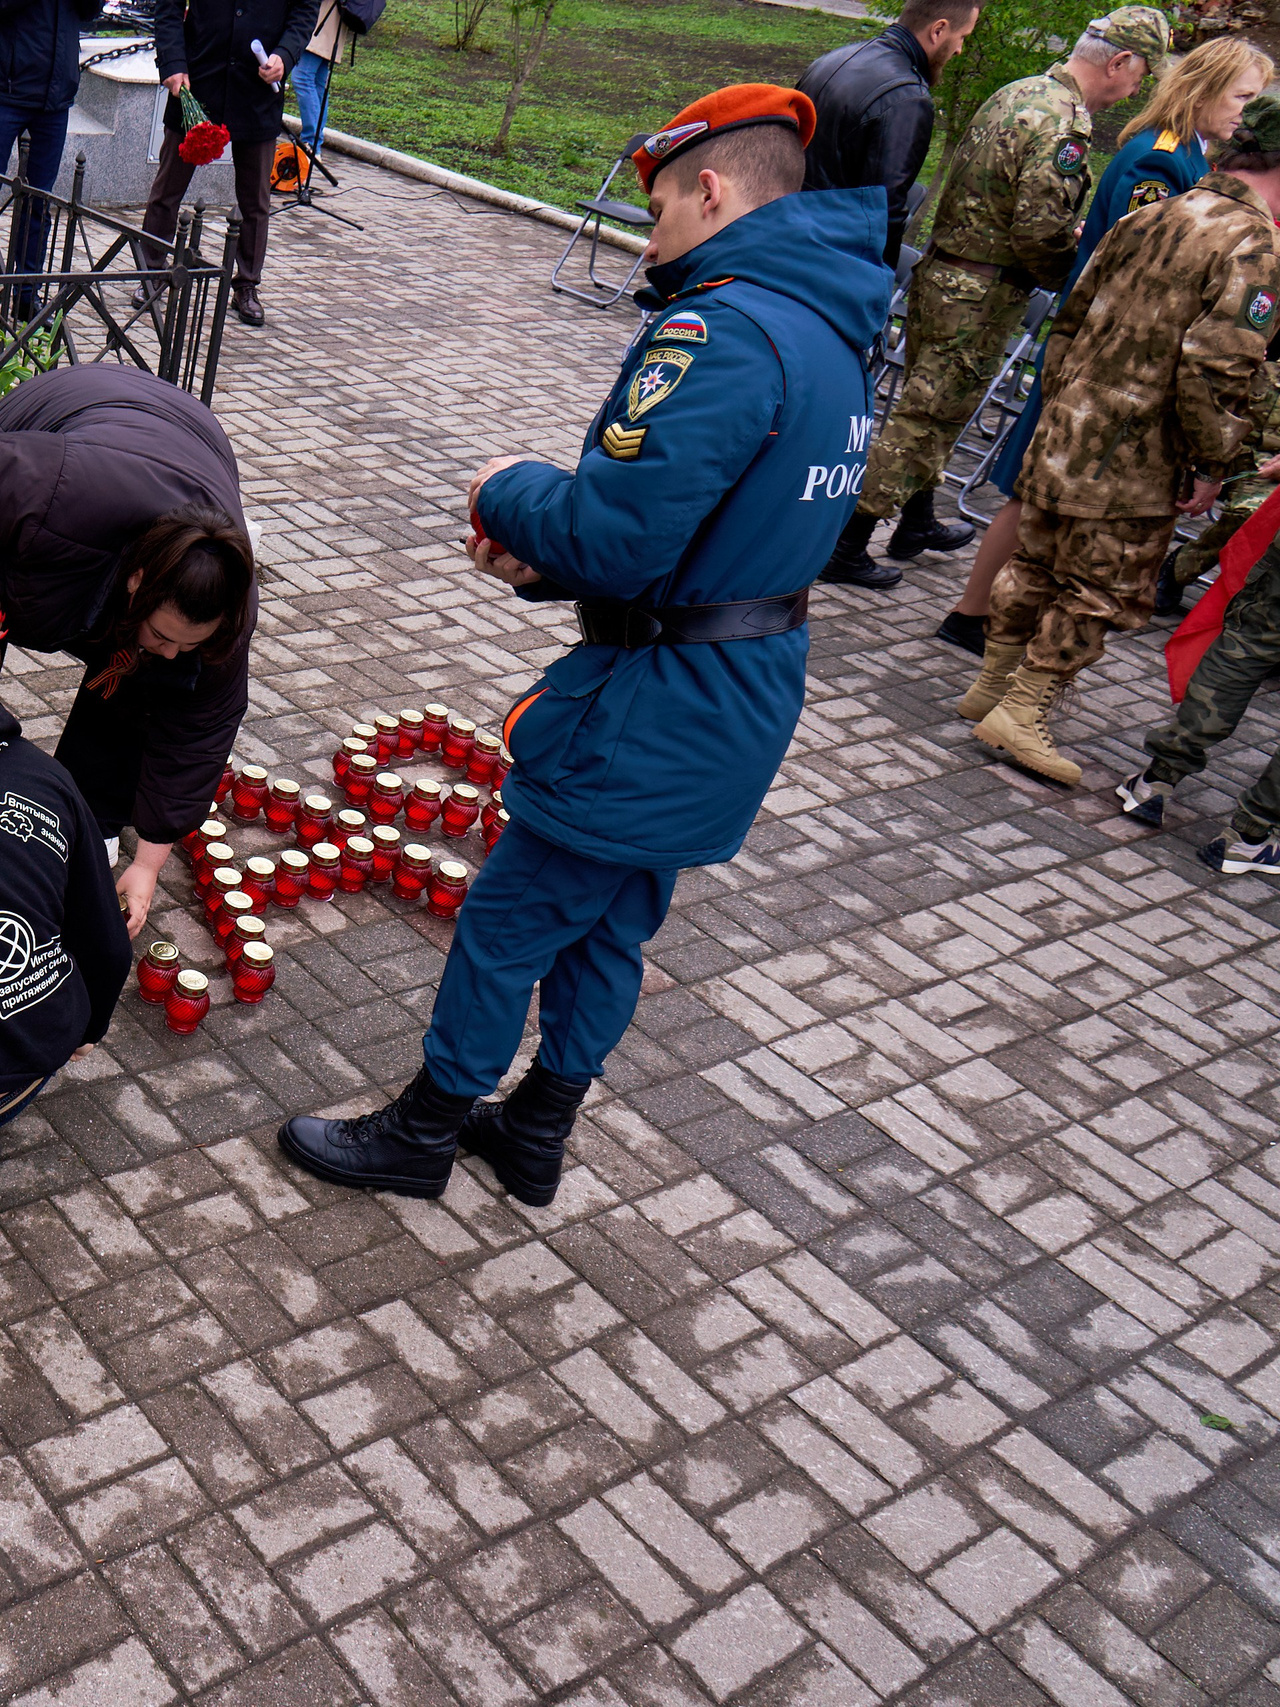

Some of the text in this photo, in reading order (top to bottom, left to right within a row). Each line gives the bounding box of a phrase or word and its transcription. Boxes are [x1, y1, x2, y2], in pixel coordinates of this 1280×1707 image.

[663, 327, 697, 337] РОССИЯ
[8, 797, 56, 828] Впитываю
[40, 827, 66, 853] знания
[1, 970, 60, 1009] притяжения
